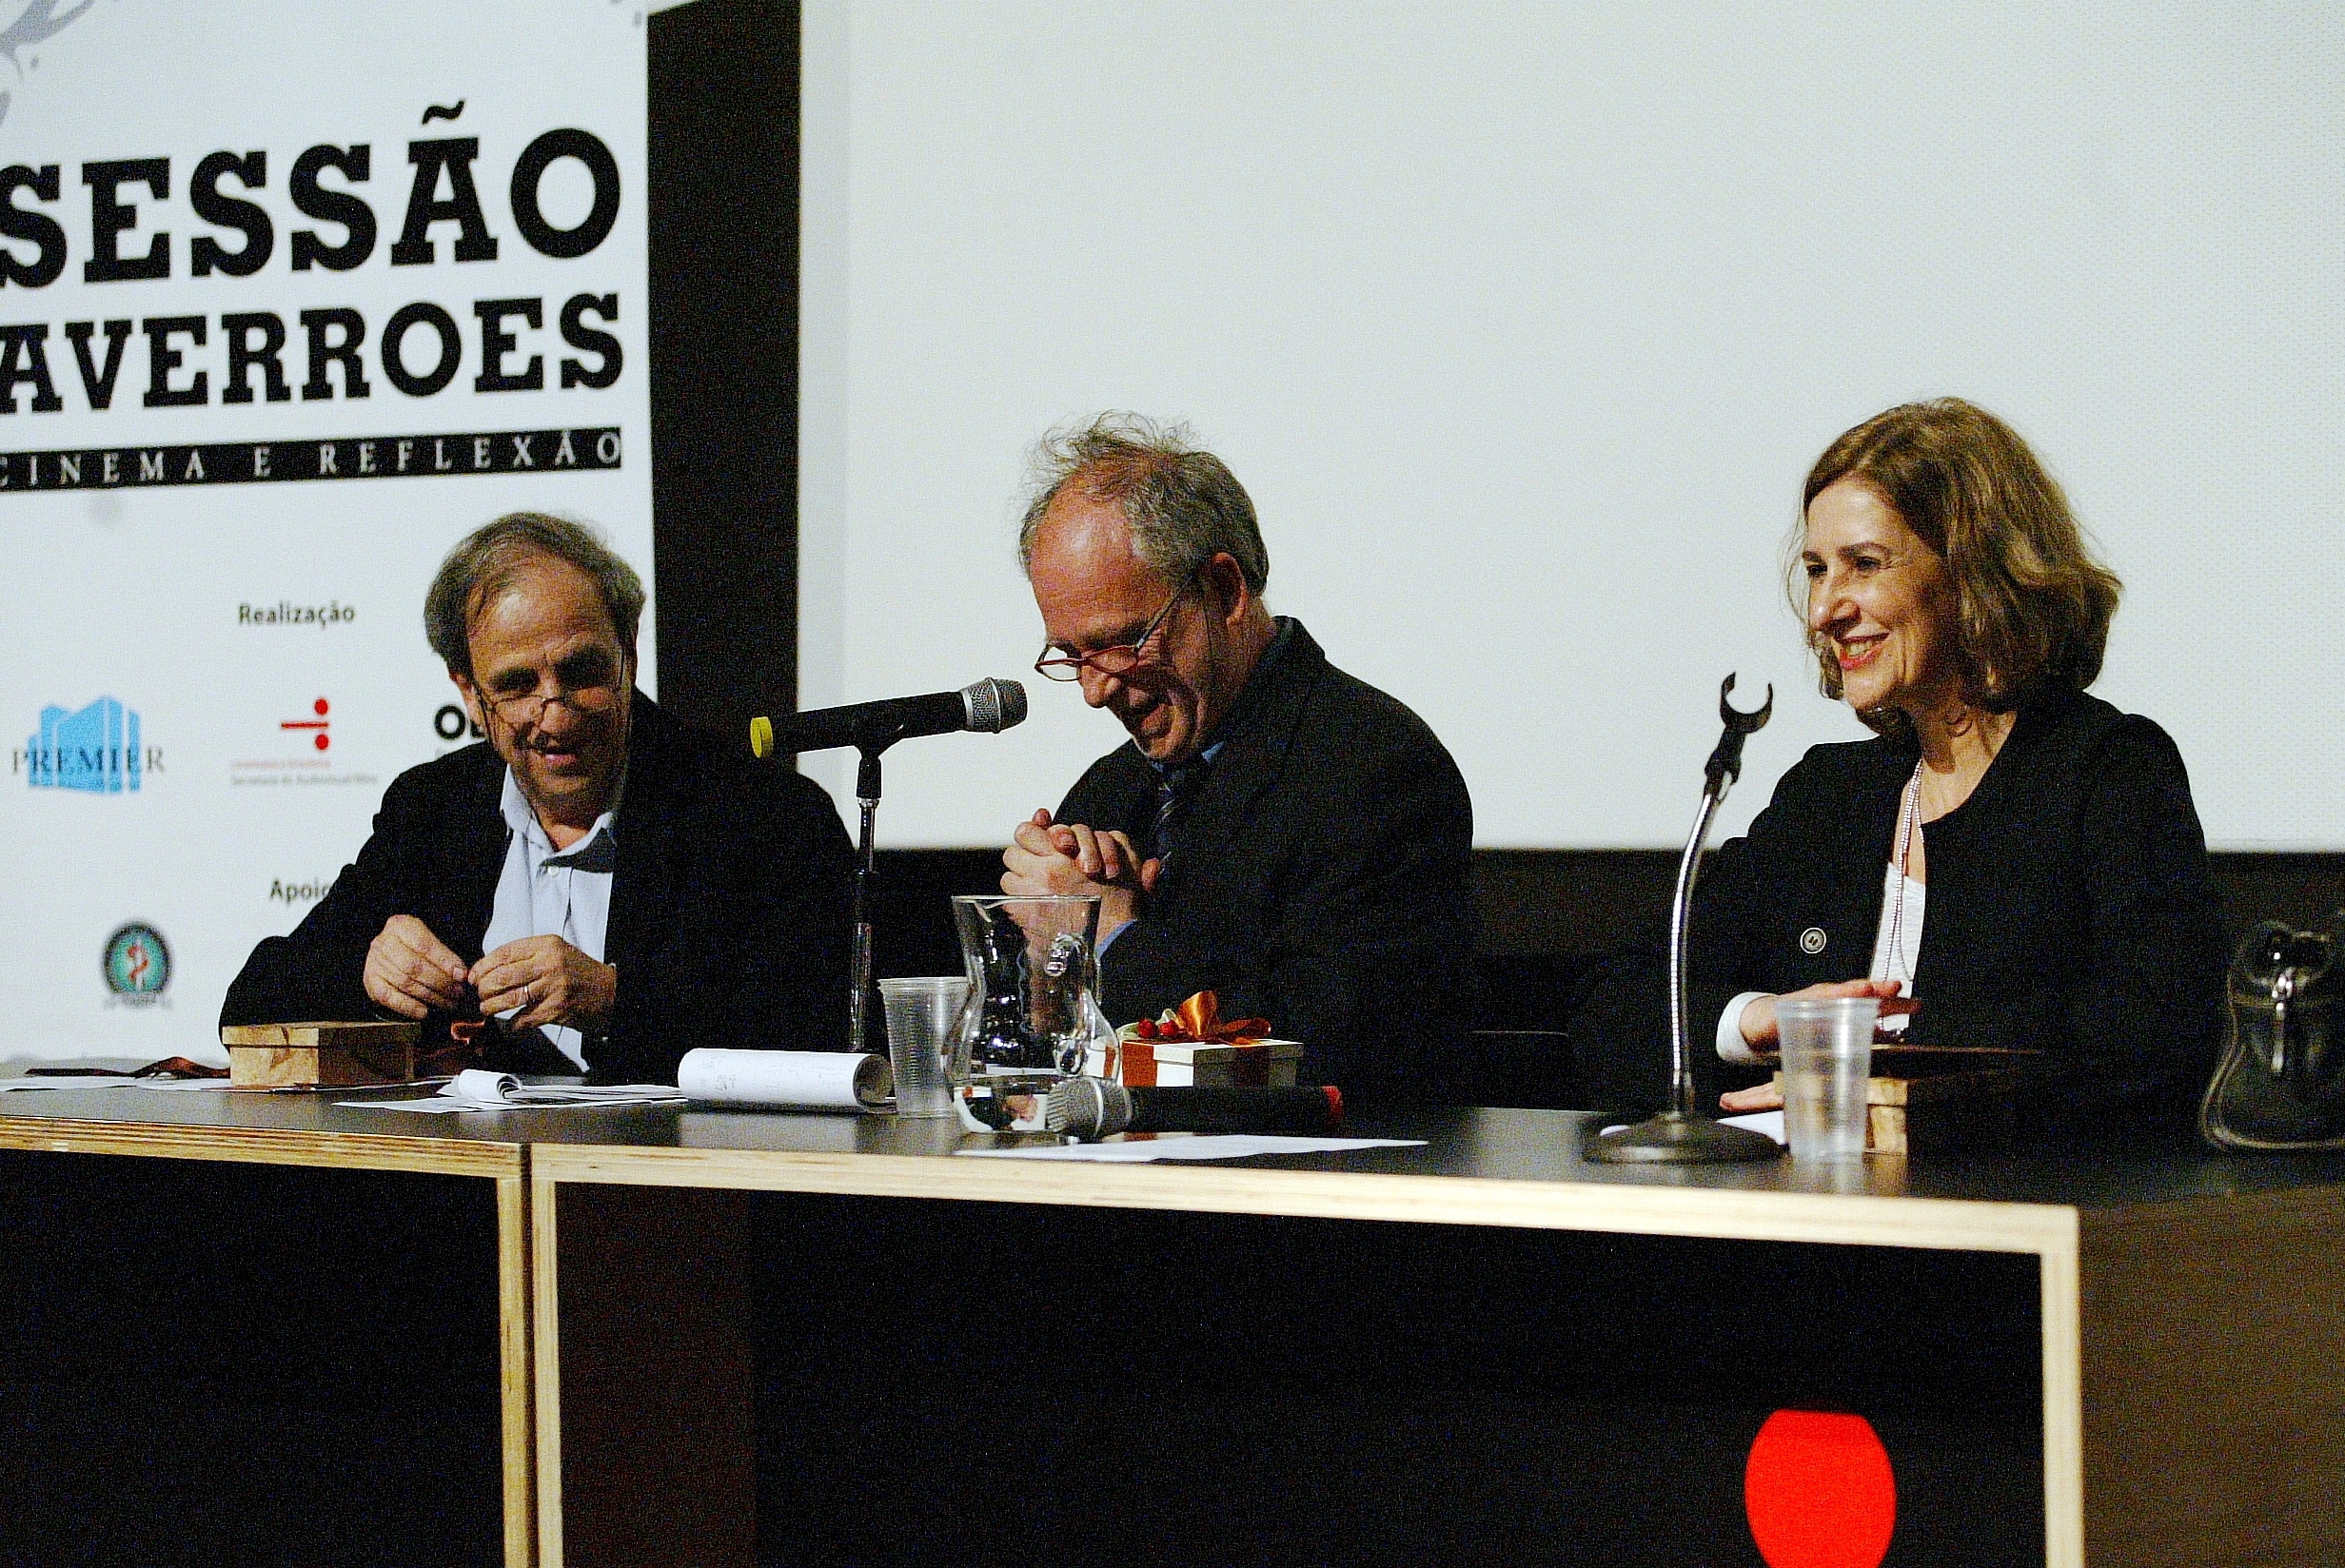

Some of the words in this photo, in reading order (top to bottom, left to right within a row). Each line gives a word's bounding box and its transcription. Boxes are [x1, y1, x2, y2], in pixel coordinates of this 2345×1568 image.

[0, 100, 621, 288] SESSÃO
[0, 293, 623, 414] AVERROES
[254, 446, 271, 476] E
[320, 431, 620, 474] REFLEXÃO
[239, 599, 355, 628] Realização
[12, 747, 165, 774] PREMIER
